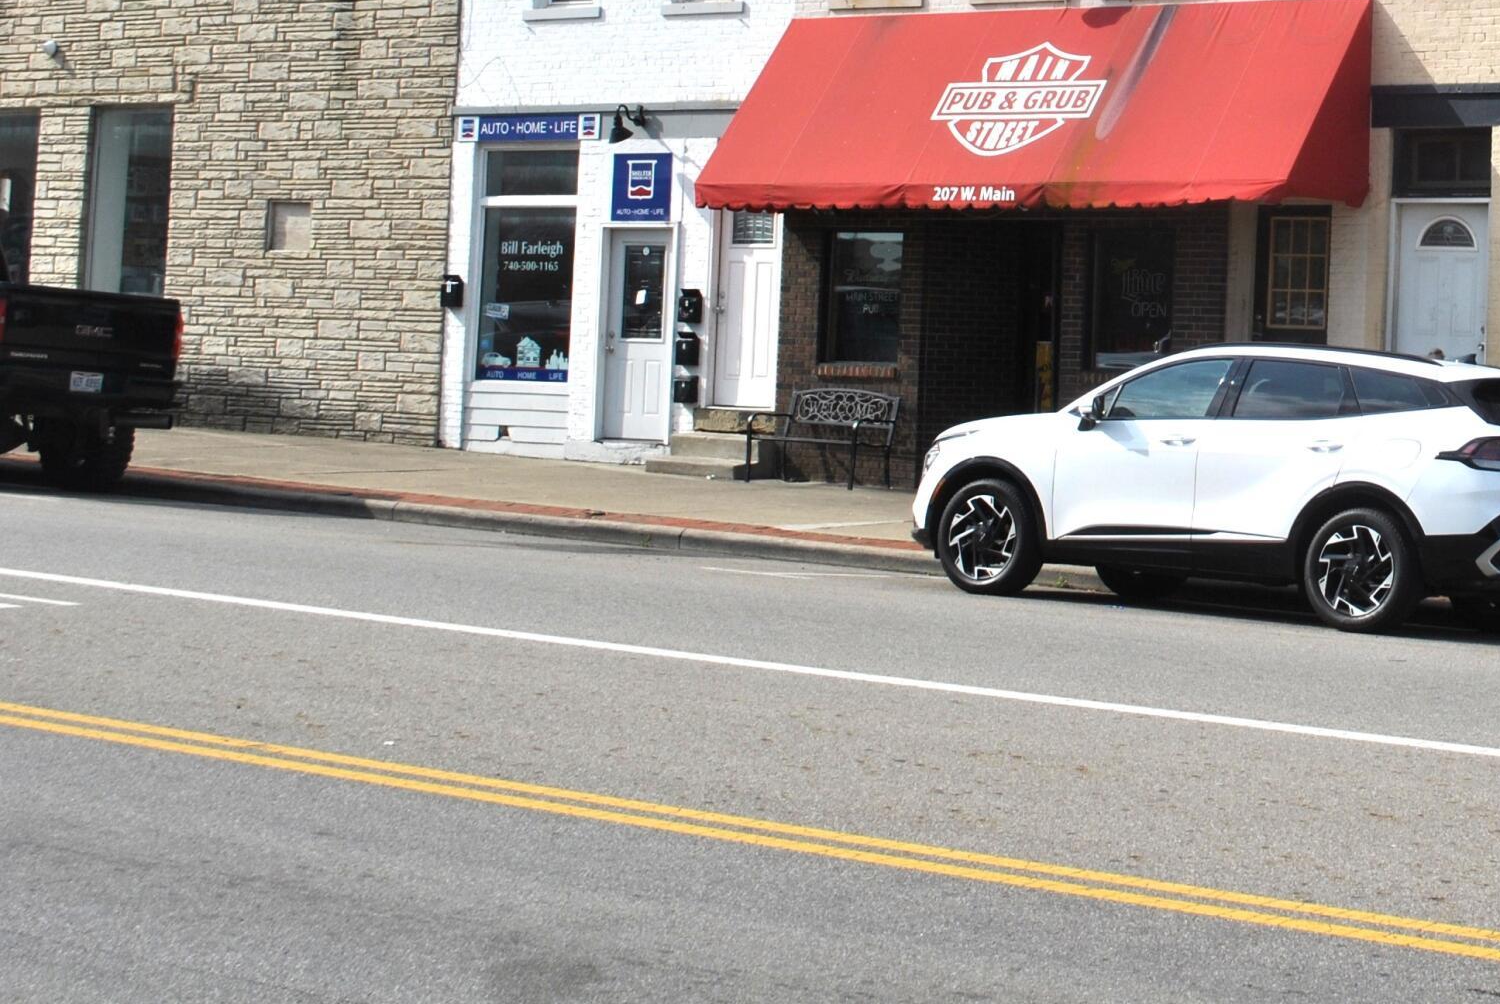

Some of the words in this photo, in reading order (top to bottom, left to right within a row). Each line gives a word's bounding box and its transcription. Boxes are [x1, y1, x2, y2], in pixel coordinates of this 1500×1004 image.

[994, 54, 1070, 81] MAIN
[947, 91, 996, 110] PUB
[999, 91, 1017, 110] &
[1024, 90, 1091, 110] GRUB
[481, 122, 509, 135] AUTO
[516, 121, 547, 134] HOME
[554, 120, 577, 133] LIFE
[966, 121, 1040, 149] STREET
[932, 187, 958, 201] 207
[961, 187, 976, 201] W.
[979, 186, 1015, 201] Main
[501, 242, 518, 255] Bill
[521, 241, 563, 258] Farleigh
[503, 261, 559, 271] 740-500-1165
[1131, 301, 1167, 317] OPEN
[75, 325, 113, 337] GMC
[486, 370, 504, 379] AUTO
[517, 371, 536, 380] HOME
[549, 372, 563, 381] LIFE
[806, 399, 877, 417] WELCOME
